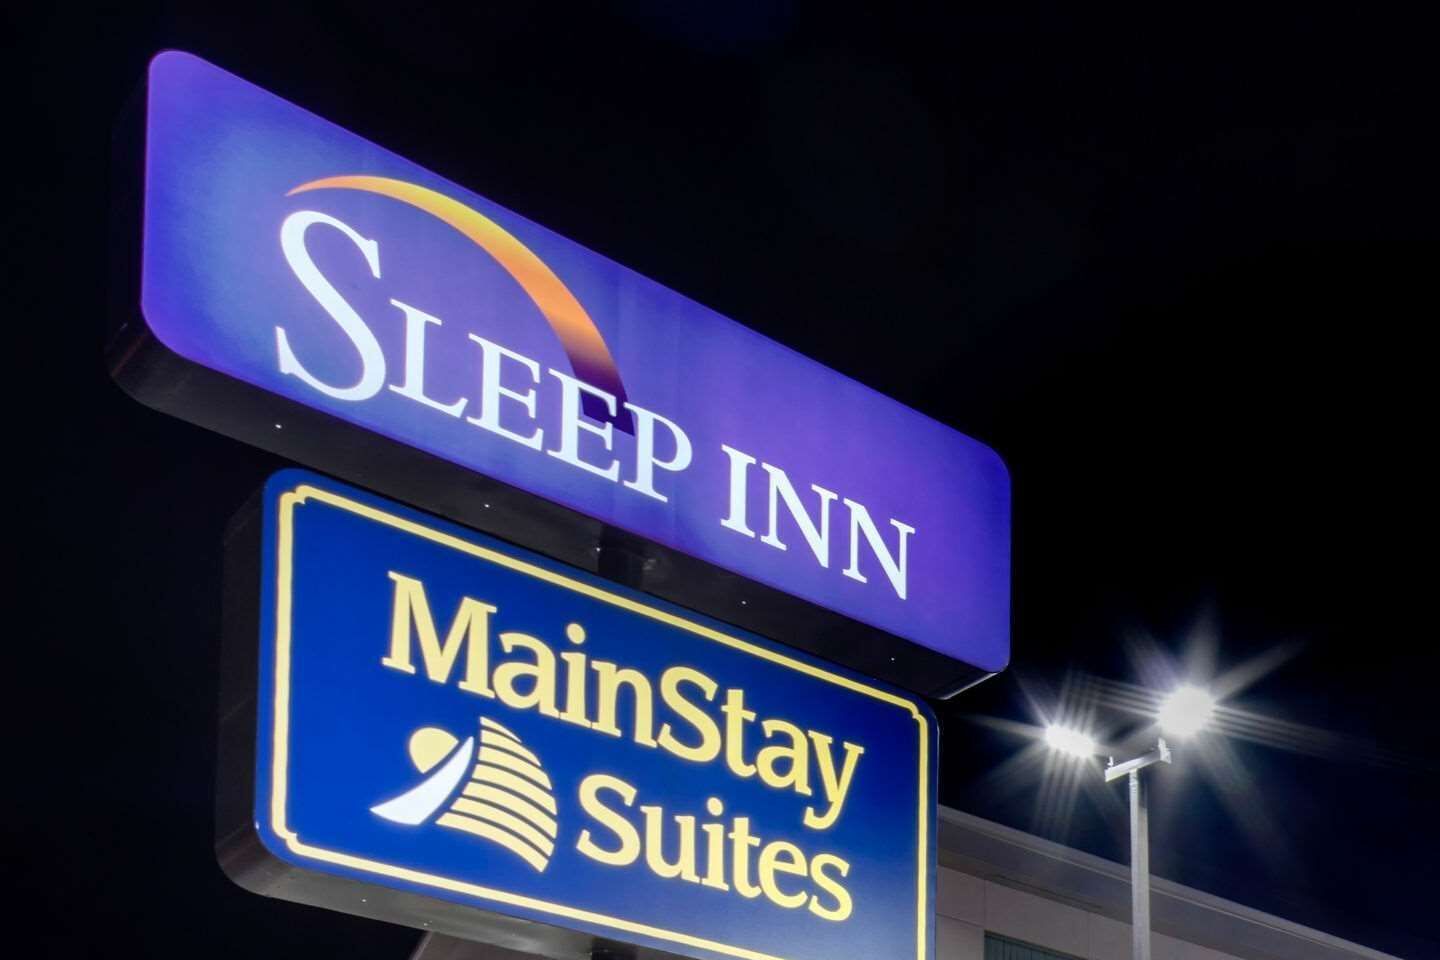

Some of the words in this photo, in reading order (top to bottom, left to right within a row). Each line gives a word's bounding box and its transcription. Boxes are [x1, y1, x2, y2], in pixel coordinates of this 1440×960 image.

[276, 208, 693, 503] SLEEP
[719, 443, 916, 601] INN
[381, 570, 865, 830] MainStay
[575, 774, 854, 922] Suites
